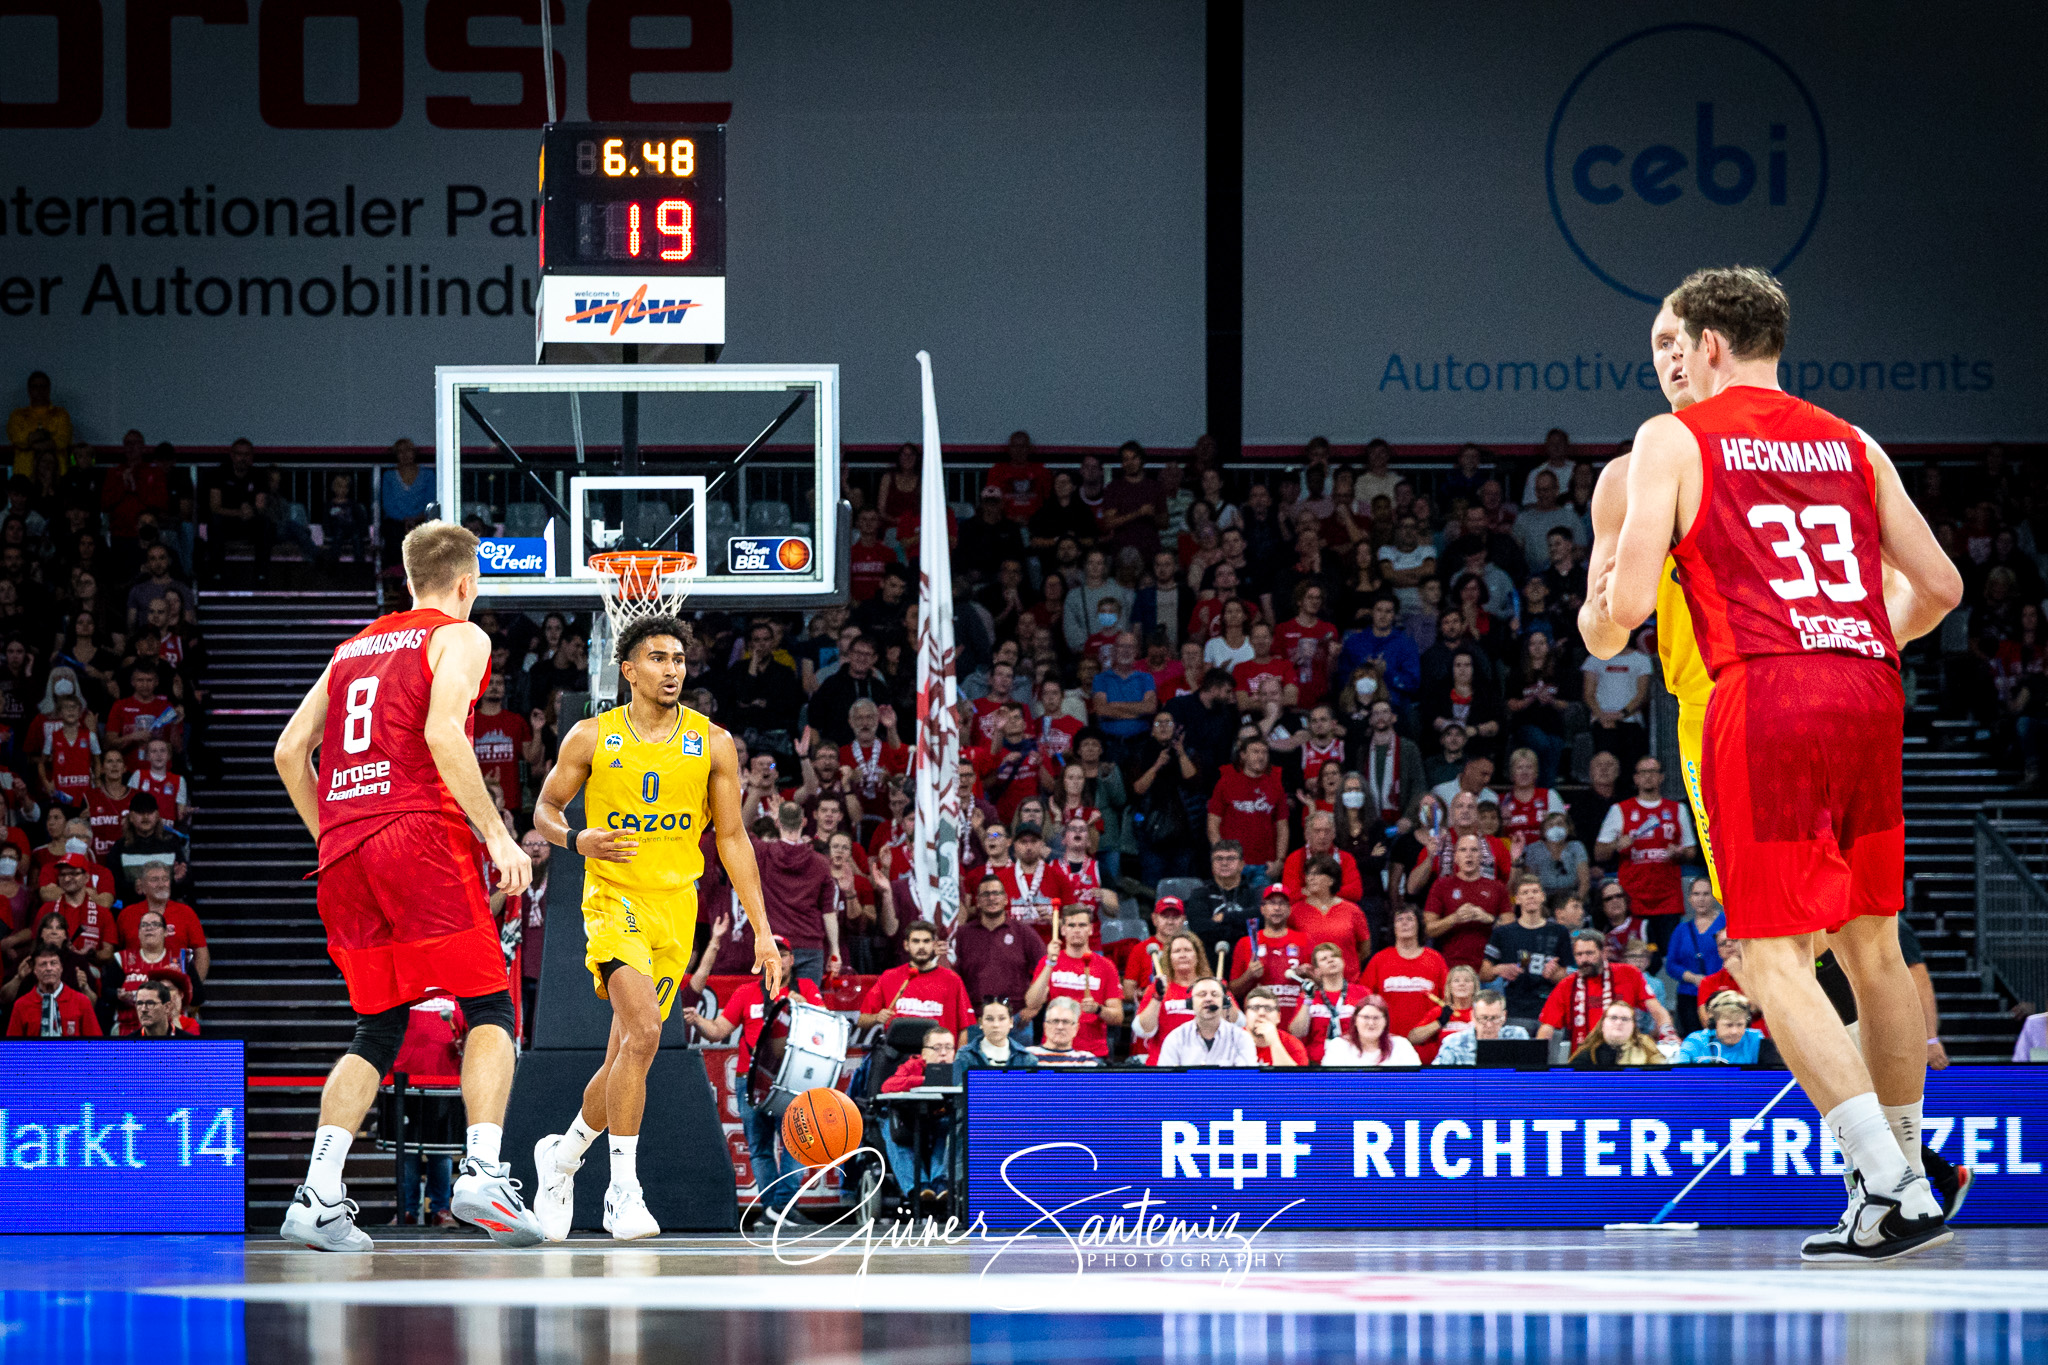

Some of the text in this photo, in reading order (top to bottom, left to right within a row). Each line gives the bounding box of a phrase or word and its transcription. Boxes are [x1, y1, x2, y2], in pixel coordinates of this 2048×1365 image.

[602, 138, 695, 177] 6.48
[1572, 101, 1789, 206] cebi
[0, 185, 424, 237] ternationaler
[629, 200, 692, 261] 19
[574, 290, 620, 298] welcome to
[574, 299, 692, 324] WOW
[1379, 353, 1994, 399] Automotive ponents
[1720, 438, 1853, 473] HECKMANN
[490, 555, 543, 570] Credit
[735, 554, 770, 569] BBL
[745, 546, 770, 555] Credit
[1746, 504, 1869, 603] 33
[343, 675, 380, 755] 8
[326, 780, 391, 801] bamberg
[331, 760, 391, 789] brose
[642, 771, 660, 803] 0
[90, 815, 119, 826] REWE
[607, 811, 692, 833] CAZOO
[166, 1107, 244, 1166] 14
